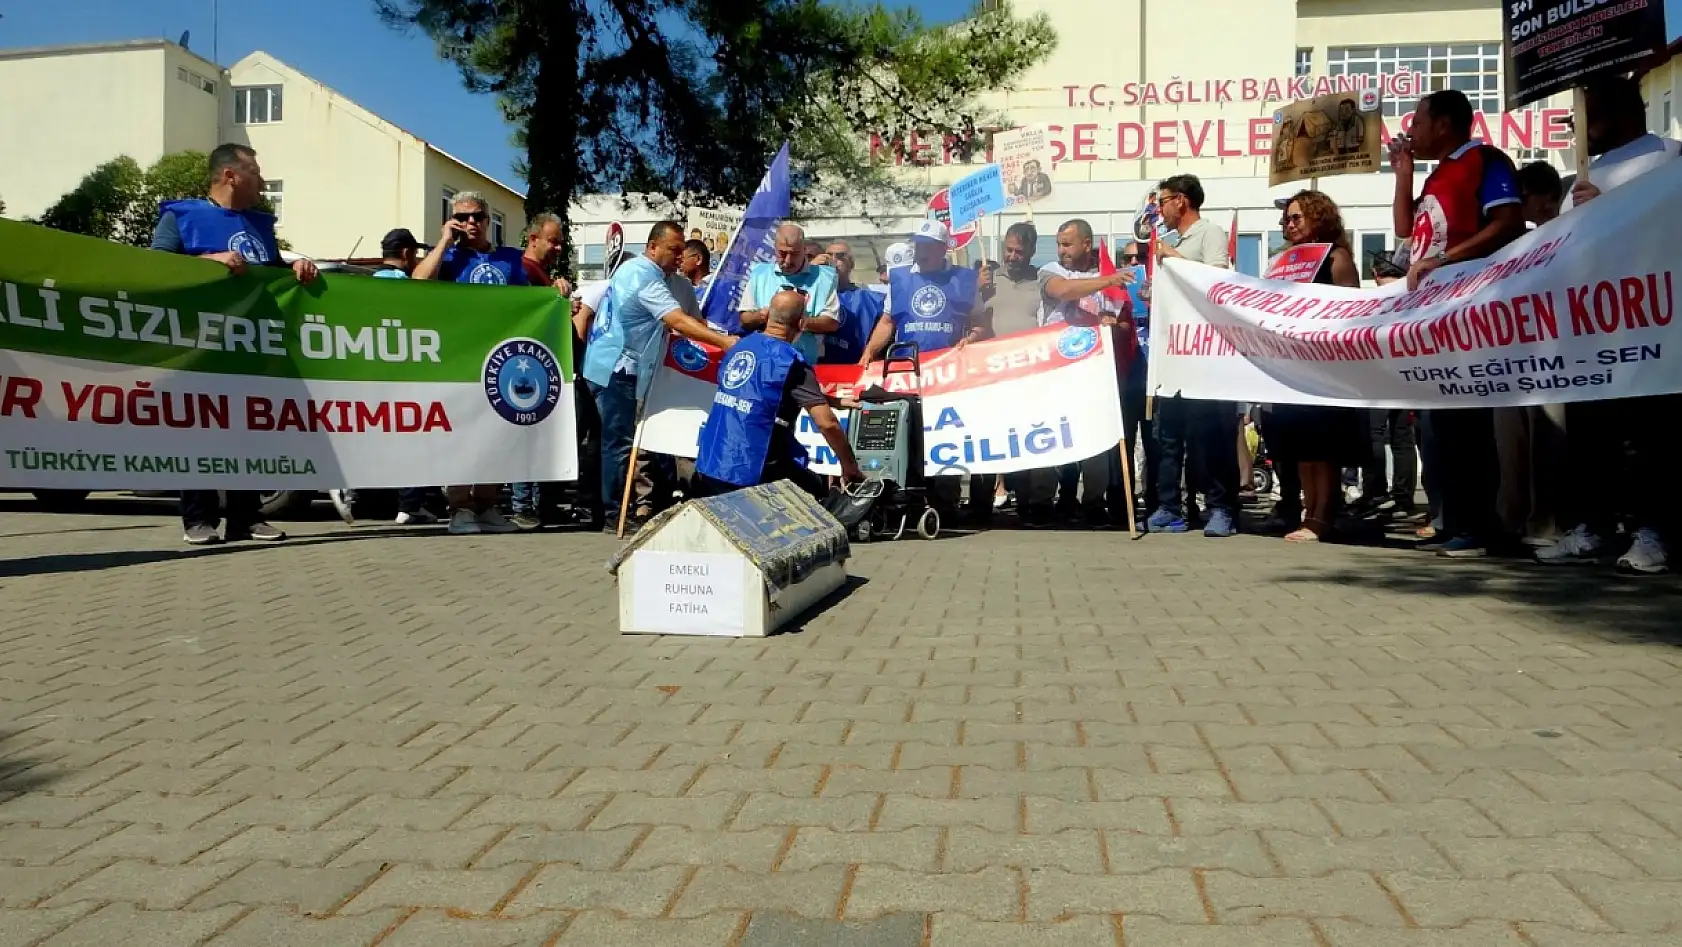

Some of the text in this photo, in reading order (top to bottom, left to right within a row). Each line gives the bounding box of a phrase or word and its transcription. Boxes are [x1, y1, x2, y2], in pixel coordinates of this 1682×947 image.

[1511, 14, 1543, 41] SON
[1063, 84, 1114, 107] T.C.
[1123, 75, 1232, 105] SAĞLIK
[1207, 281, 1322, 320] MEMURLAR
[1310, 298, 1379, 321] YERDE
[1388, 290, 1559, 359] ZULMÜNDEN
[1566, 270, 1674, 338] KORU
[0, 278, 442, 363] Lİ SİZLERE ÖMÜR
[986, 347, 1051, 373] SEN
[1399, 365, 1463, 383] TÜRK
[1468, 354, 1566, 379] EĞİTİM
[1597, 343, 1662, 365] SEN
[1438, 369, 1614, 397] Muğla Şubesi
[61, 380, 230, 430] YOĞUN
[246, 395, 453, 433] BAKIMDA
[516, 412, 537, 423] 1992
[6, 446, 317, 475] TÜRKİYE KAMU SEN MUĞLA
[669, 563, 710, 576] EMEKLİ
[665, 583, 714, 596] RUHUNA
[669, 601, 709, 614] FATİHA
